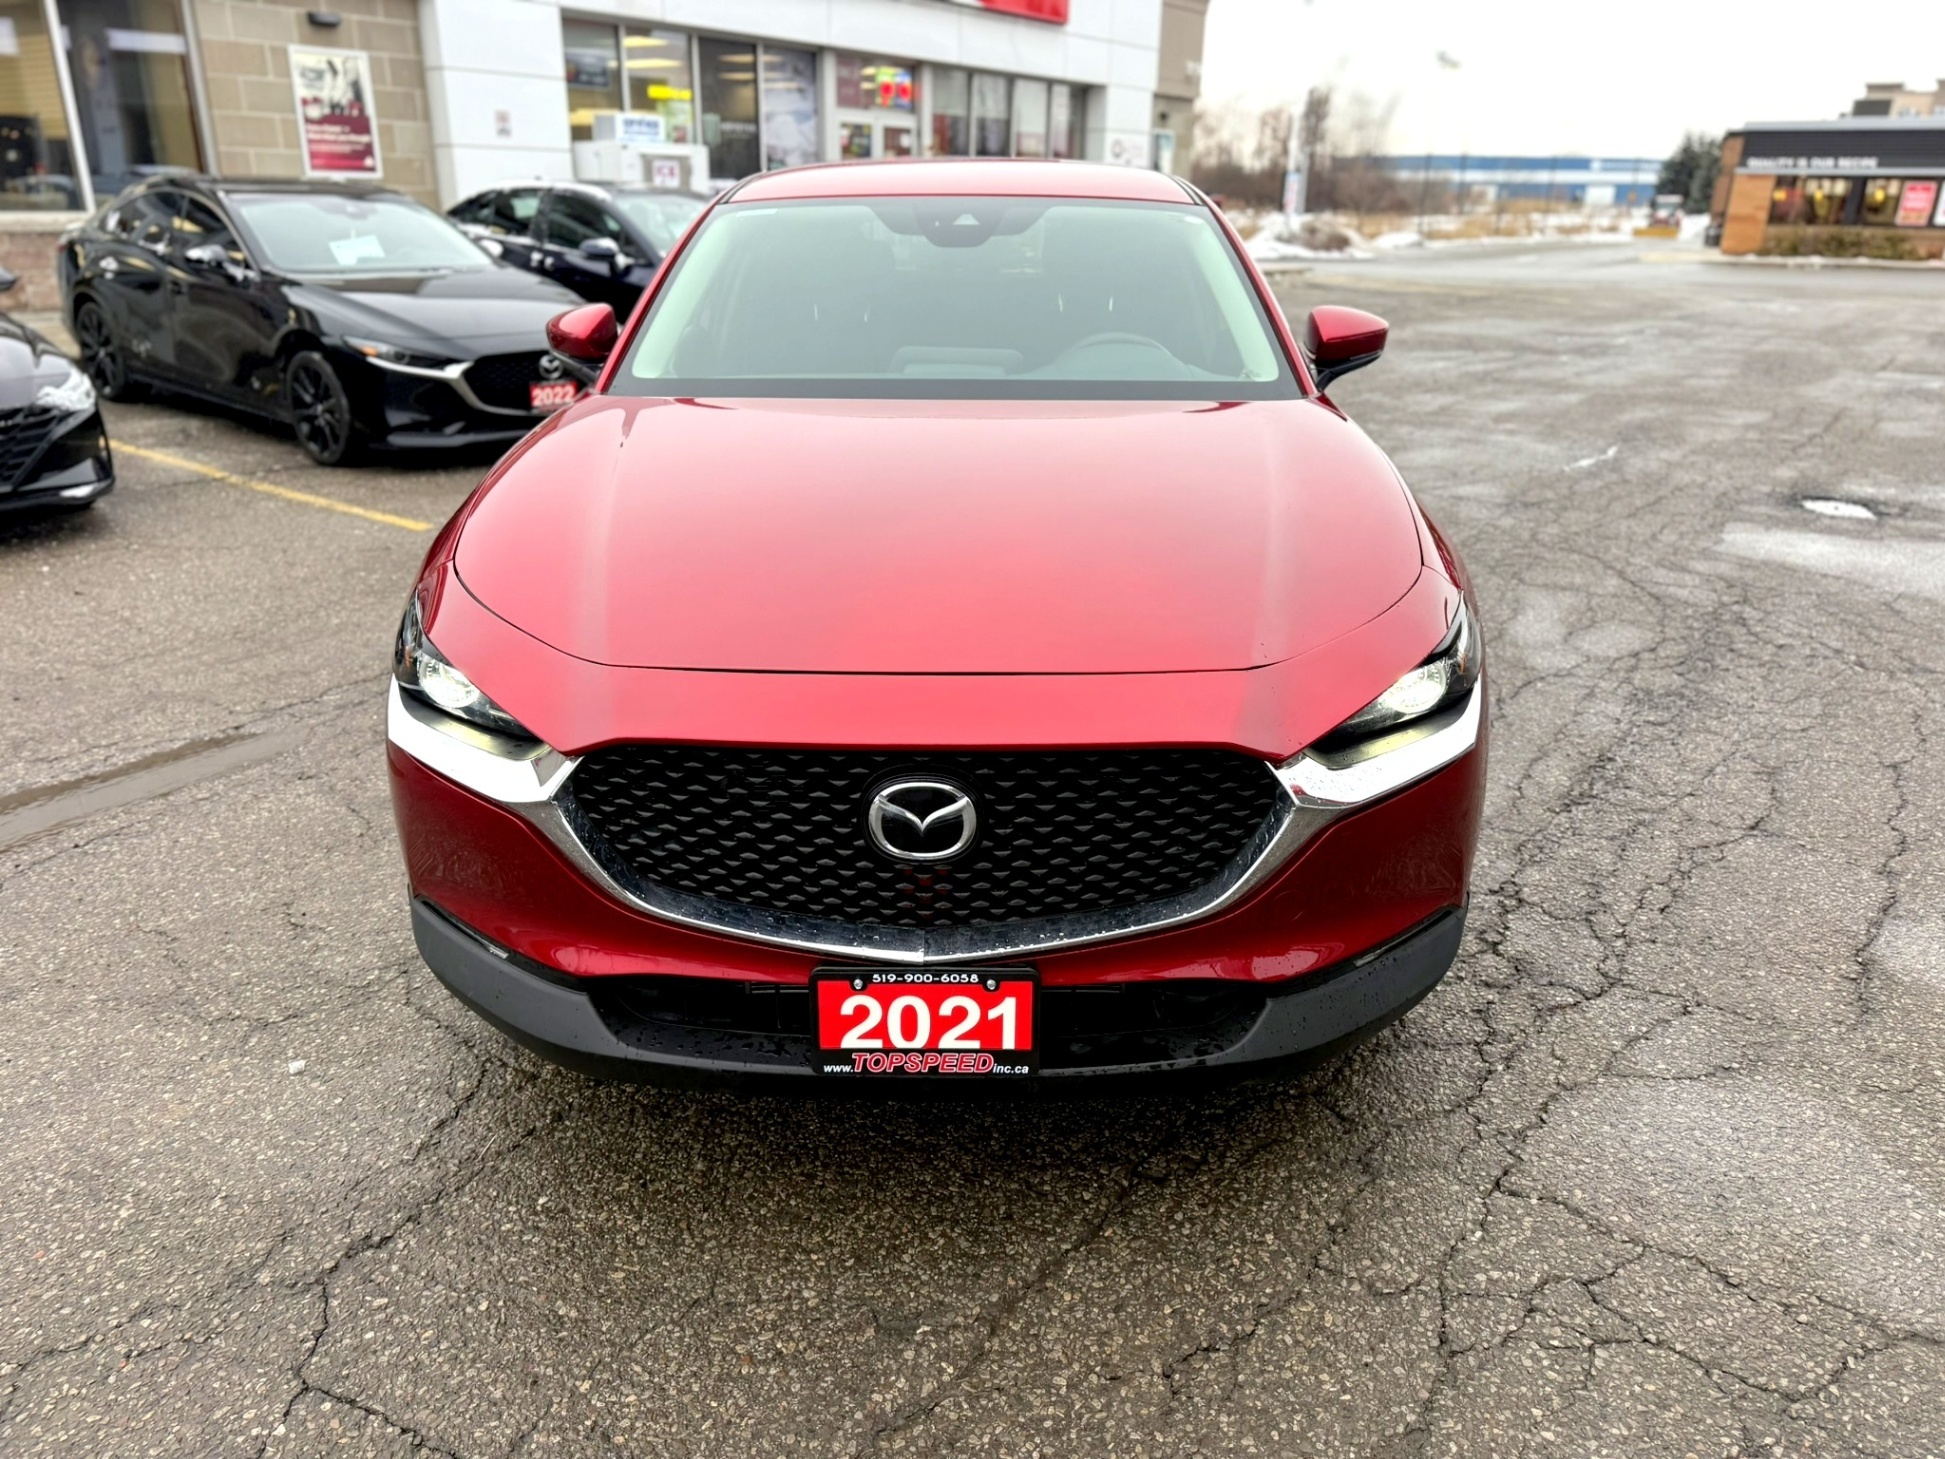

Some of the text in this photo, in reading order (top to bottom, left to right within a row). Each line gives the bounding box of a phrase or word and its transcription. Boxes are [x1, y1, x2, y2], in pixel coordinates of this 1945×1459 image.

[531, 385, 575, 406] 2022
[872, 973, 979, 983] 519-900-6058
[840, 994, 1017, 1050] 2021
